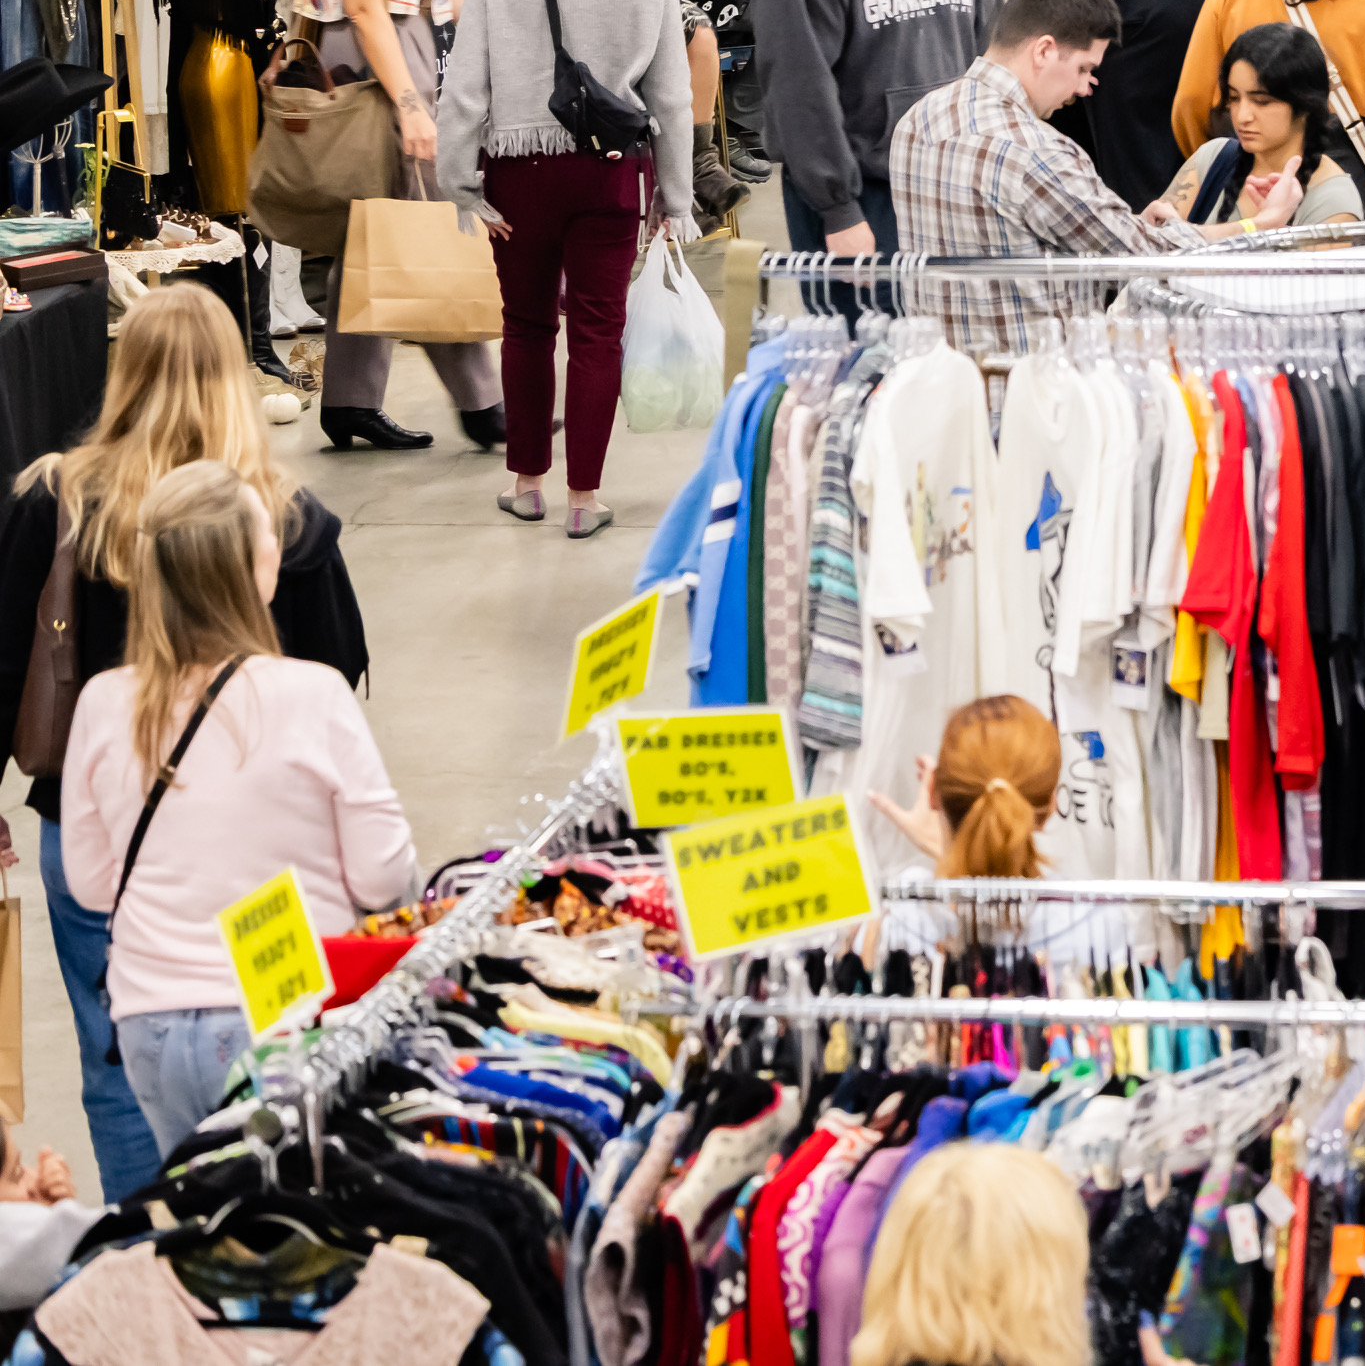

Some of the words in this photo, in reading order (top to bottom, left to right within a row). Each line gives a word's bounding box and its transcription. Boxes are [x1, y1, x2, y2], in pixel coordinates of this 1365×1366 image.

[681, 731, 778, 748] DRESSES
[726, 788, 768, 803] Y2K
[677, 808, 848, 869] SWEATERS
[741, 861, 802, 894] AND
[731, 894, 830, 934] VESTS
